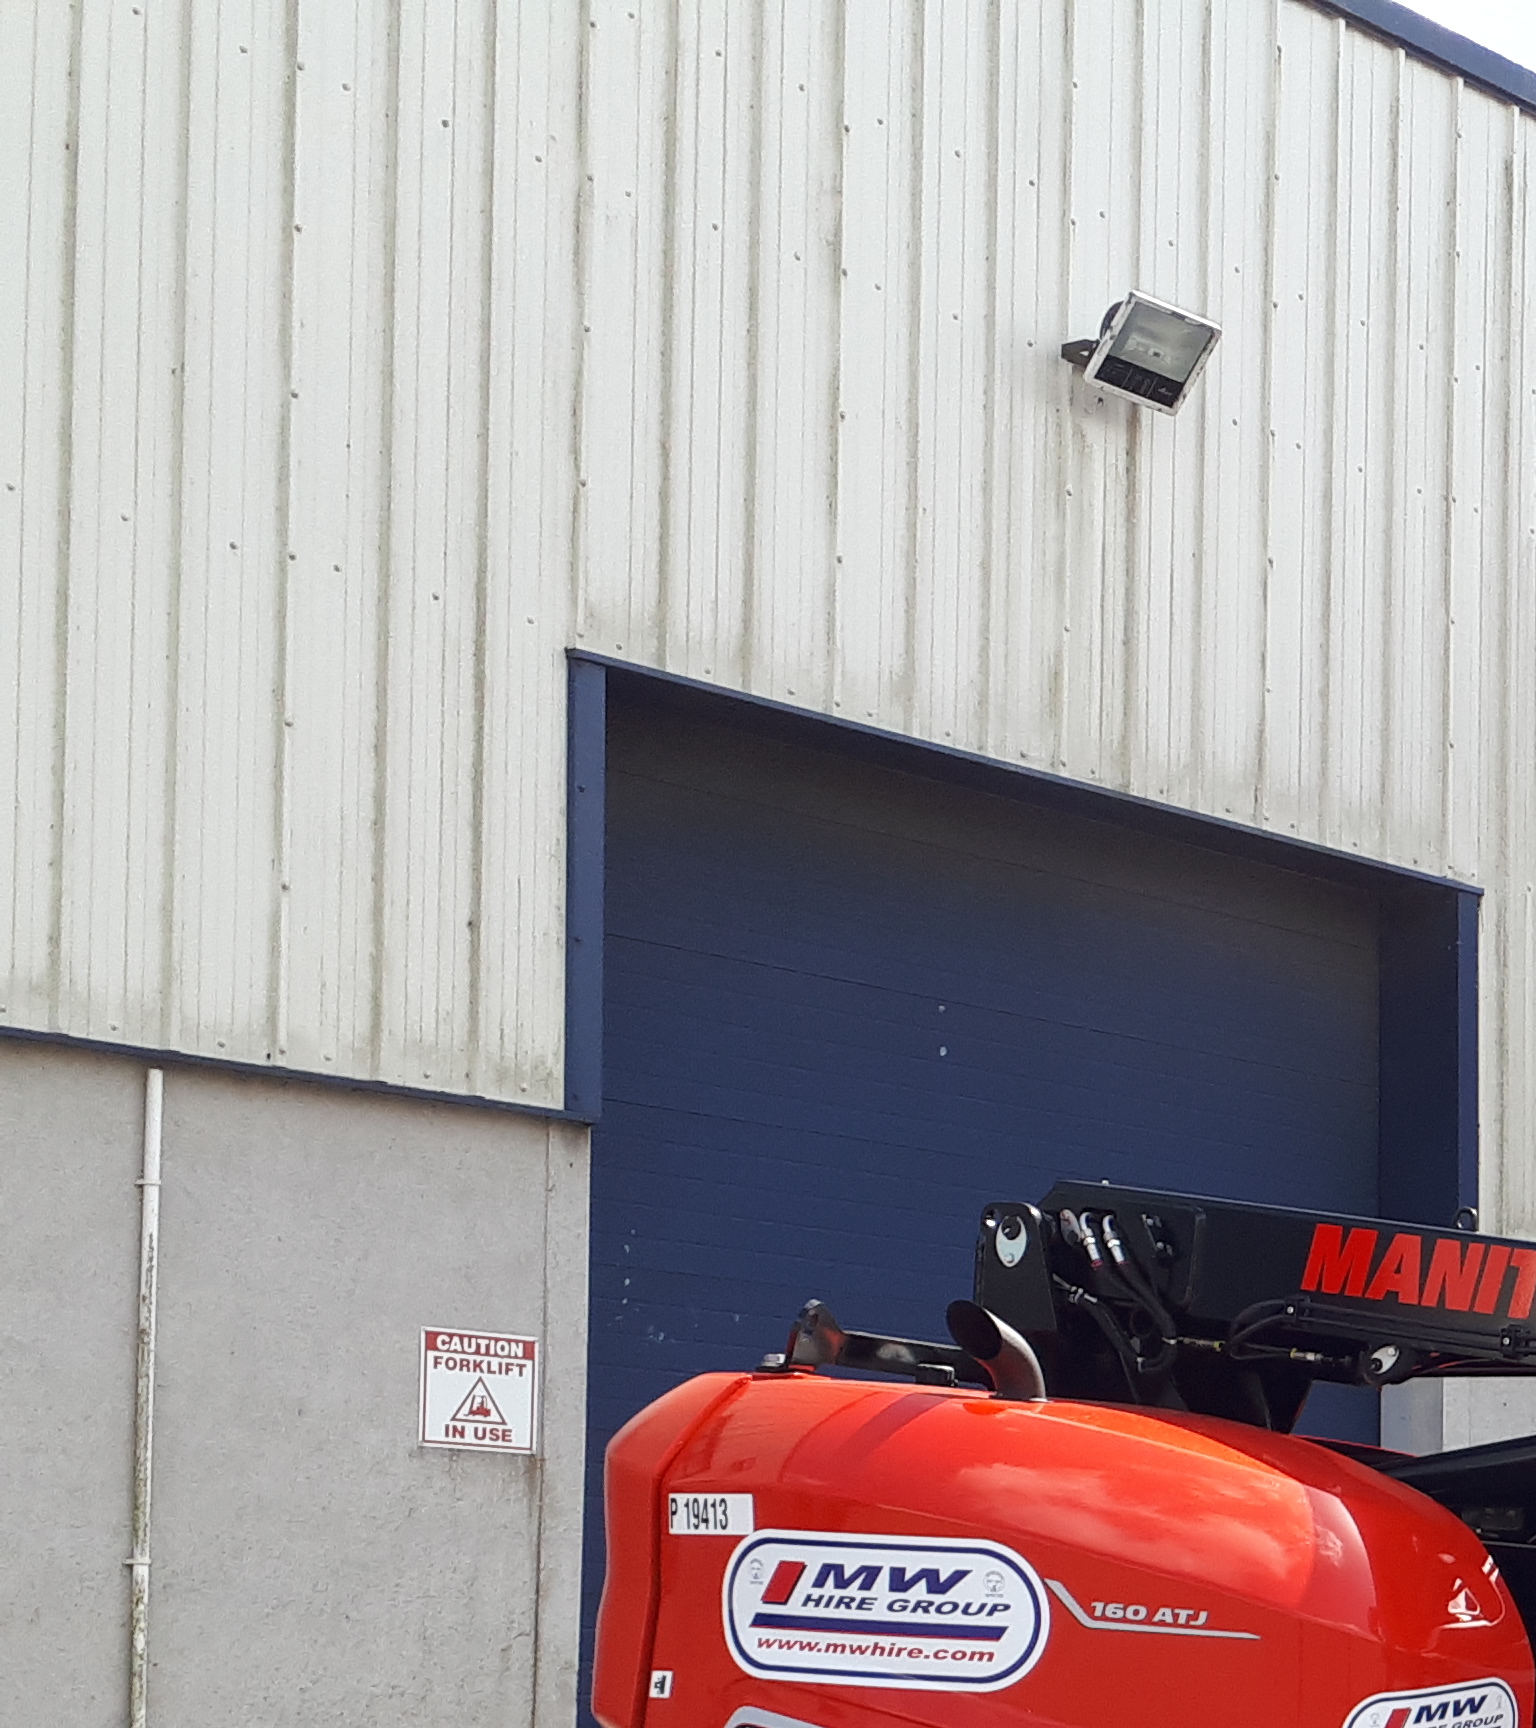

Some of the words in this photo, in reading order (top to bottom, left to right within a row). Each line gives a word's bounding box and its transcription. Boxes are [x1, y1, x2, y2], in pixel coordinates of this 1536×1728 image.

[436, 1334, 524, 1358] CAUTION
[433, 1355, 527, 1377] FORKLIFT
[444, 1423, 466, 1439] IN
[474, 1426, 513, 1443] USE
[670, 1498, 678, 1529] P
[684, 1497, 728, 1530] 19413
[811, 1562, 973, 1595] MW
[800, 1593, 878, 1612] HIRE
[886, 1599, 1012, 1617] GROUP
[1090, 1601, 1148, 1621] 160
[1152, 1607, 1208, 1626] ATJ
[757, 1636, 995, 1662] www.mwhire.com
[1413, 1694, 1489, 1725] MW
